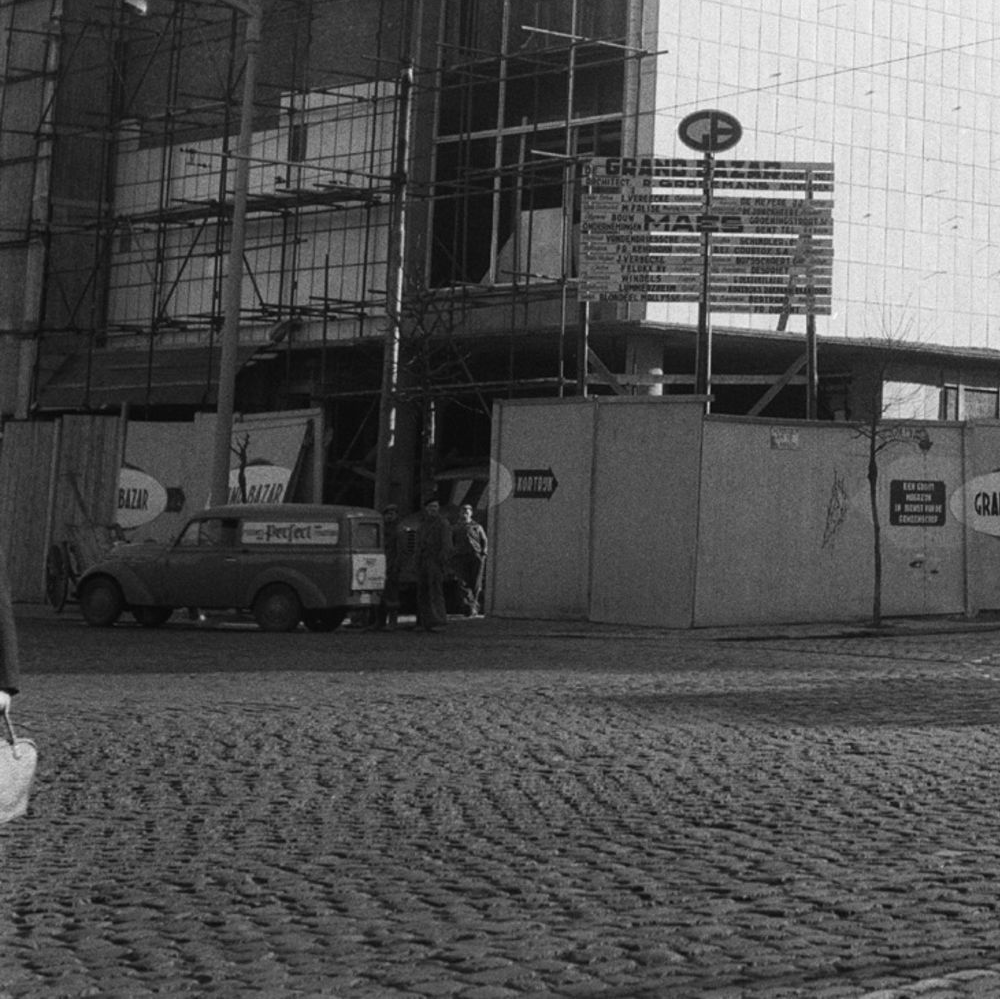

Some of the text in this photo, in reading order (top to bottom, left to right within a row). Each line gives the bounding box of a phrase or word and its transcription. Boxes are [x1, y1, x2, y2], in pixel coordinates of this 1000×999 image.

[606, 159, 687, 177] GRAND
[696, 160, 781, 179] BAZAR
[644, 215, 744, 233] MAES
[117, 487, 150, 510] BAZAR
[248, 482, 284, 504] BAZAR
